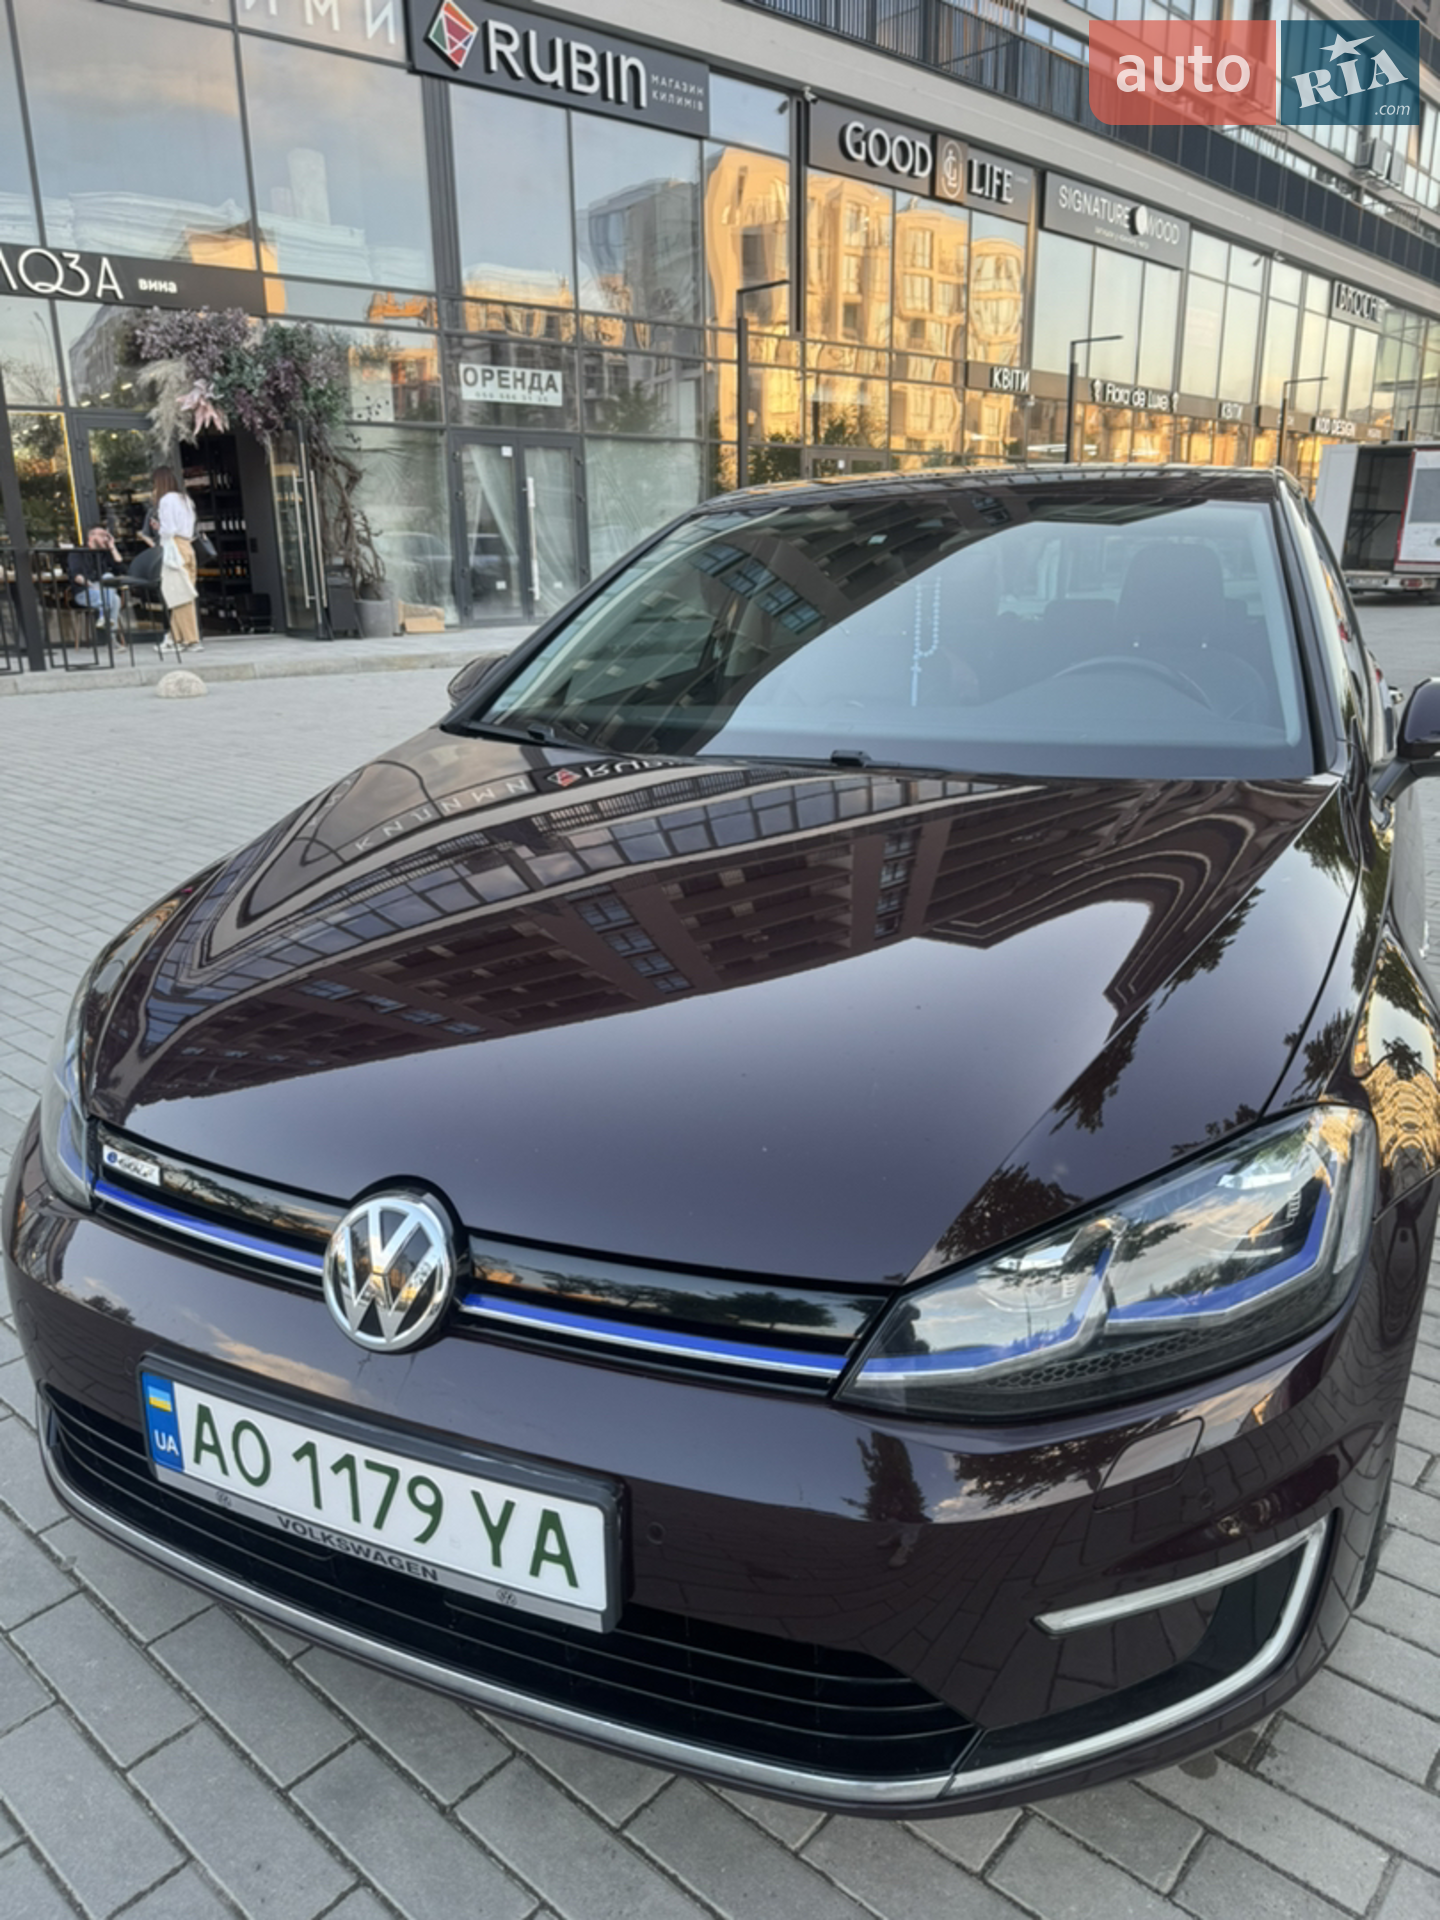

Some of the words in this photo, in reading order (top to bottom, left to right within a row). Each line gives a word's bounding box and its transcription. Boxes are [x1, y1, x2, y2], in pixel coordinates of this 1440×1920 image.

[651, 74, 704, 96] МАГАЗИН
[652, 90, 703, 111] КИЛИМІВ
[844, 121, 933, 178] GOOD
[971, 158, 1014, 204] LIFE
[1058, 185, 1131, 229] SIGNATURE
[138, 278, 178, 294] вина
[463, 366, 559, 395] ОРЕНДА
[992, 366, 1030, 393] КВІТИ
[154, 1429, 180, 1456] UA
[292, 1440, 444, 1544] 1179
[277, 1515, 439, 1582] VOLKSWAGEN
